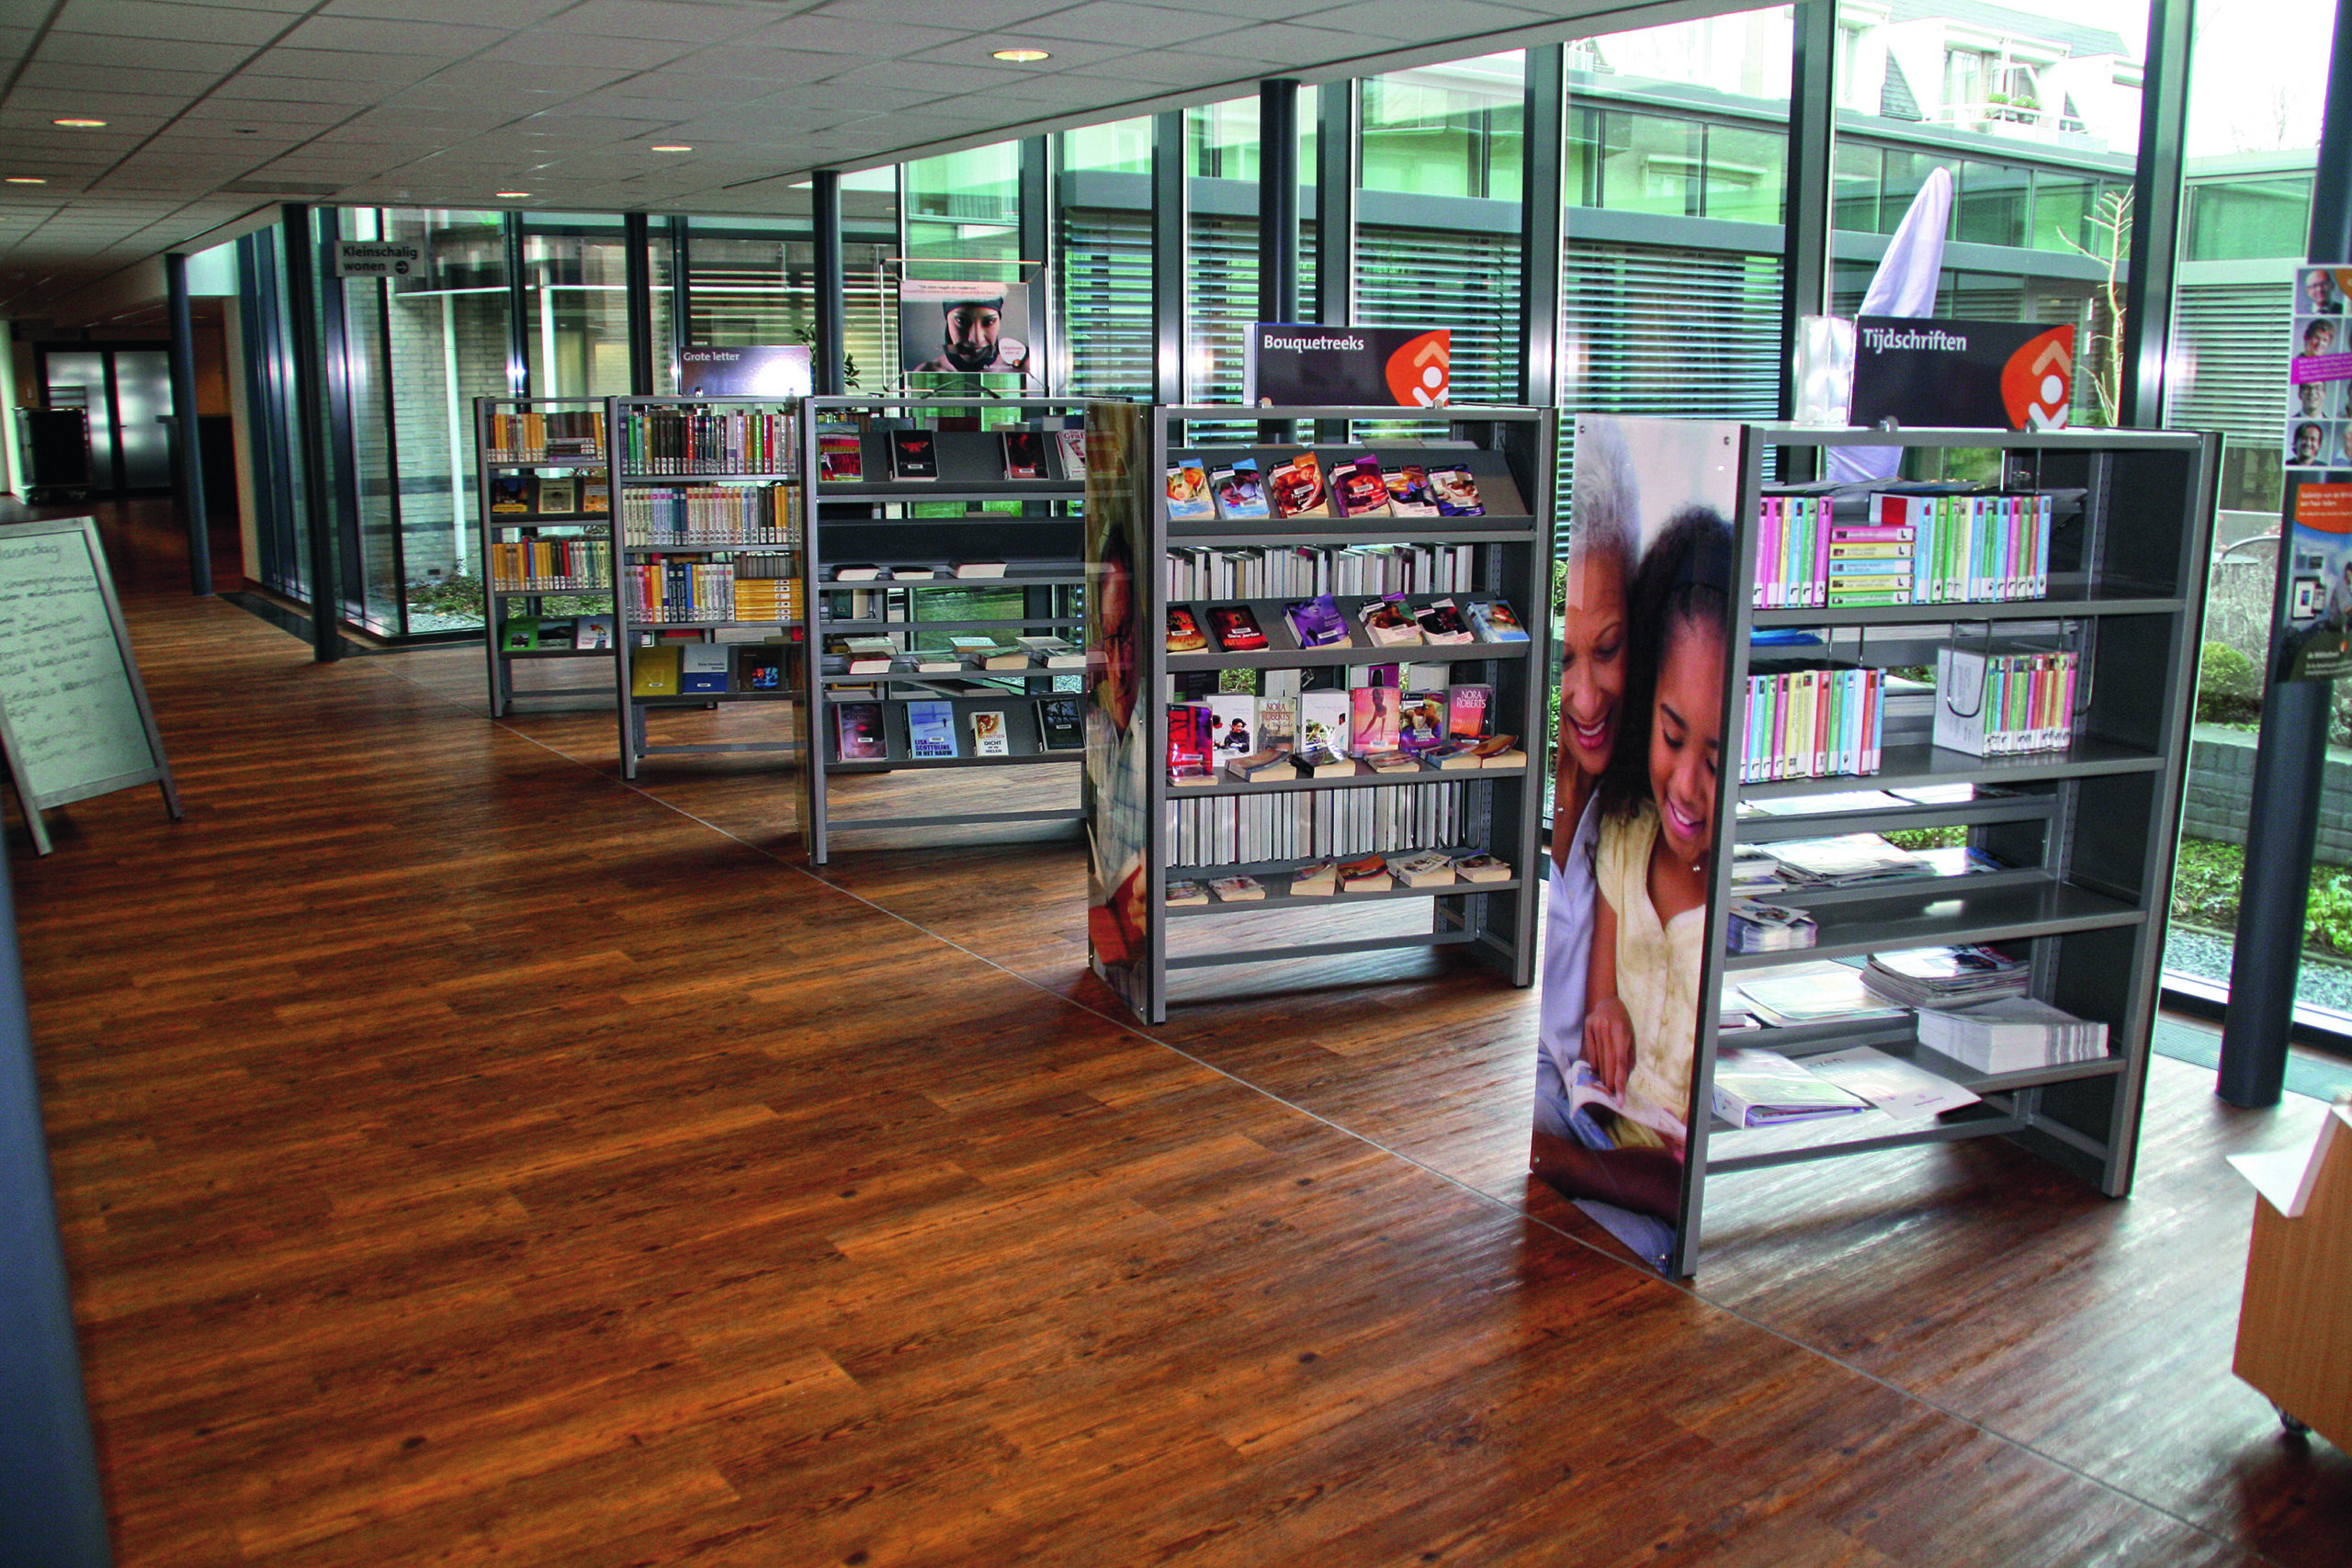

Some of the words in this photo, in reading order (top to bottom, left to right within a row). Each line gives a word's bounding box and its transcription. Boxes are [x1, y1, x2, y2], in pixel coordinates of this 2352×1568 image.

[343, 245, 418, 260] Kleinschalig
[344, 262, 386, 271] wonen
[1263, 334, 1364, 354] Bouquetreeks
[1863, 328, 1967, 354] Tijdschriften
[683, 352, 711, 362] Grote
[712, 351, 741, 361] letter
[1461, 690, 1482, 699] NORA
[1266, 703, 1286, 711] NORA
[1456, 697, 1487, 709] ROBERTS
[1261, 711, 1292, 721] ROBERTS
